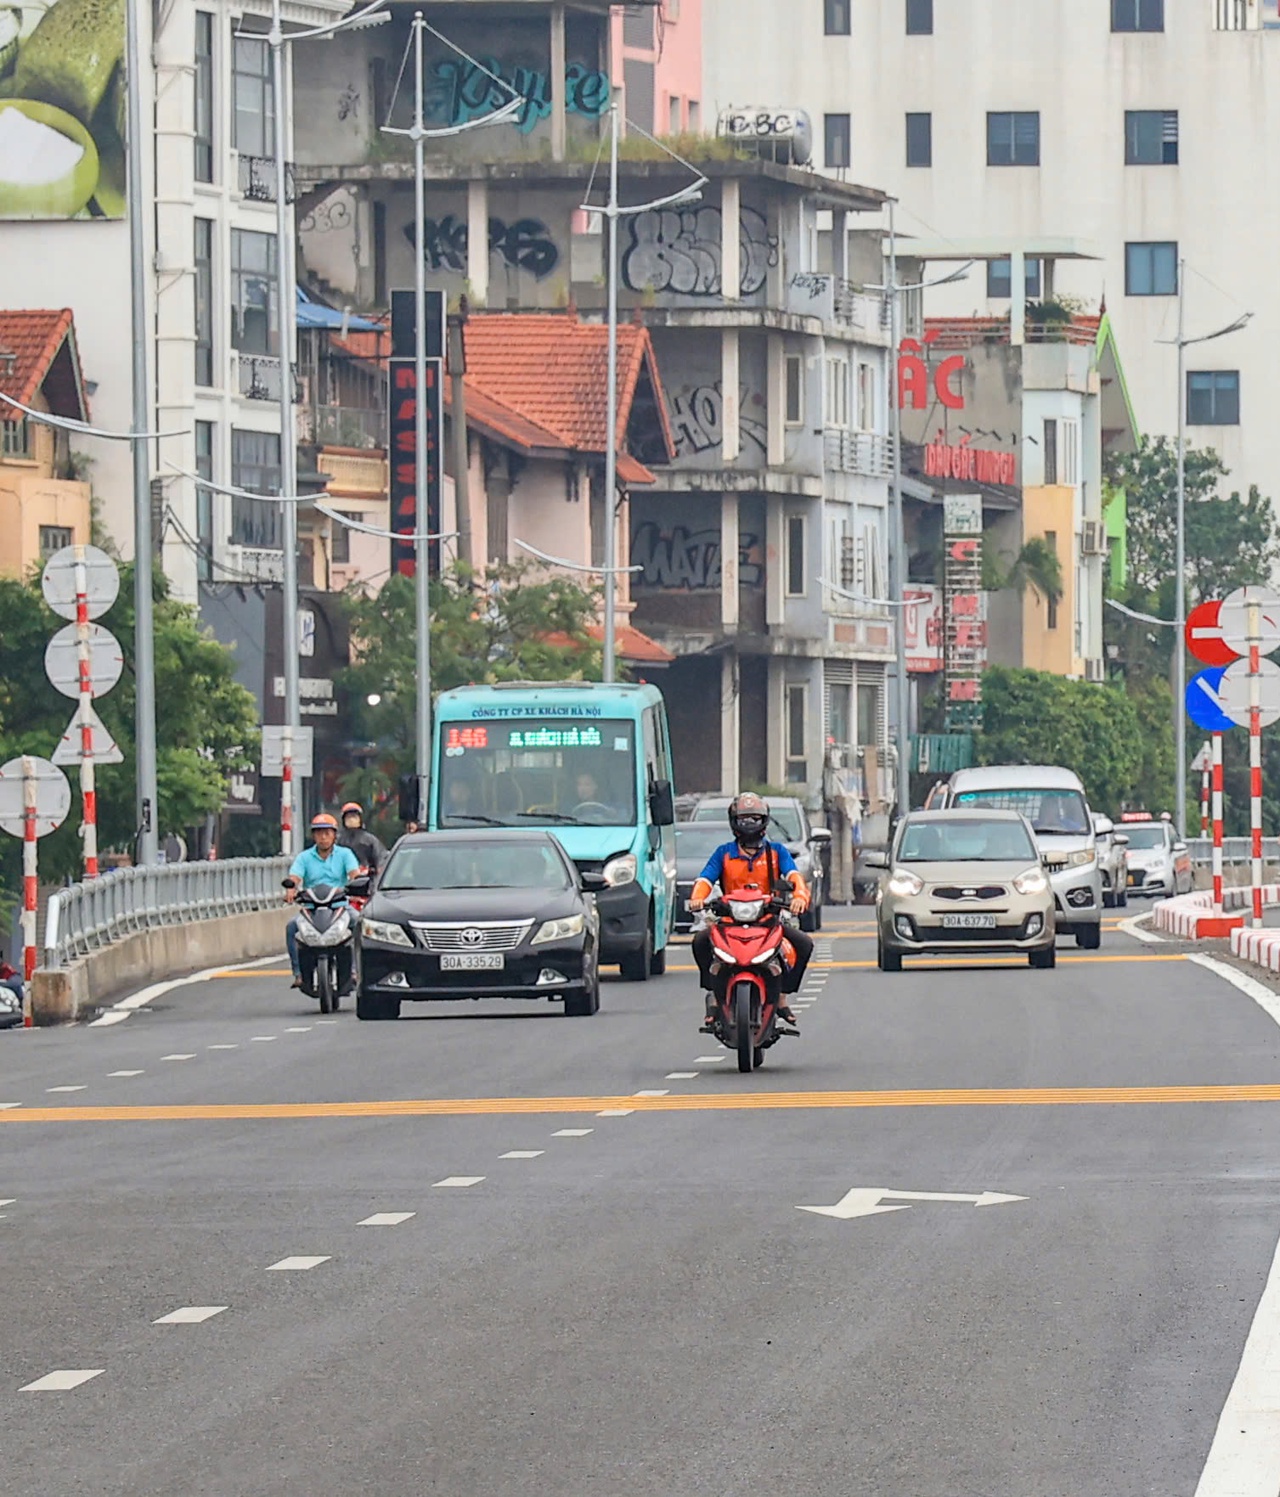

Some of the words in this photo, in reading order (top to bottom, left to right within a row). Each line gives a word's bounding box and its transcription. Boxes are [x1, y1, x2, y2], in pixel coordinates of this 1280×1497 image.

[472, 707, 497, 718] CÔNG
[498, 708, 510, 717] TY
[511, 708, 524, 717] CP
[525, 708, 537, 716] XE
[538, 706, 569, 716] KHÁCH
[571, 706, 583, 716] HÀ
[585, 706, 601, 718] NỘI
